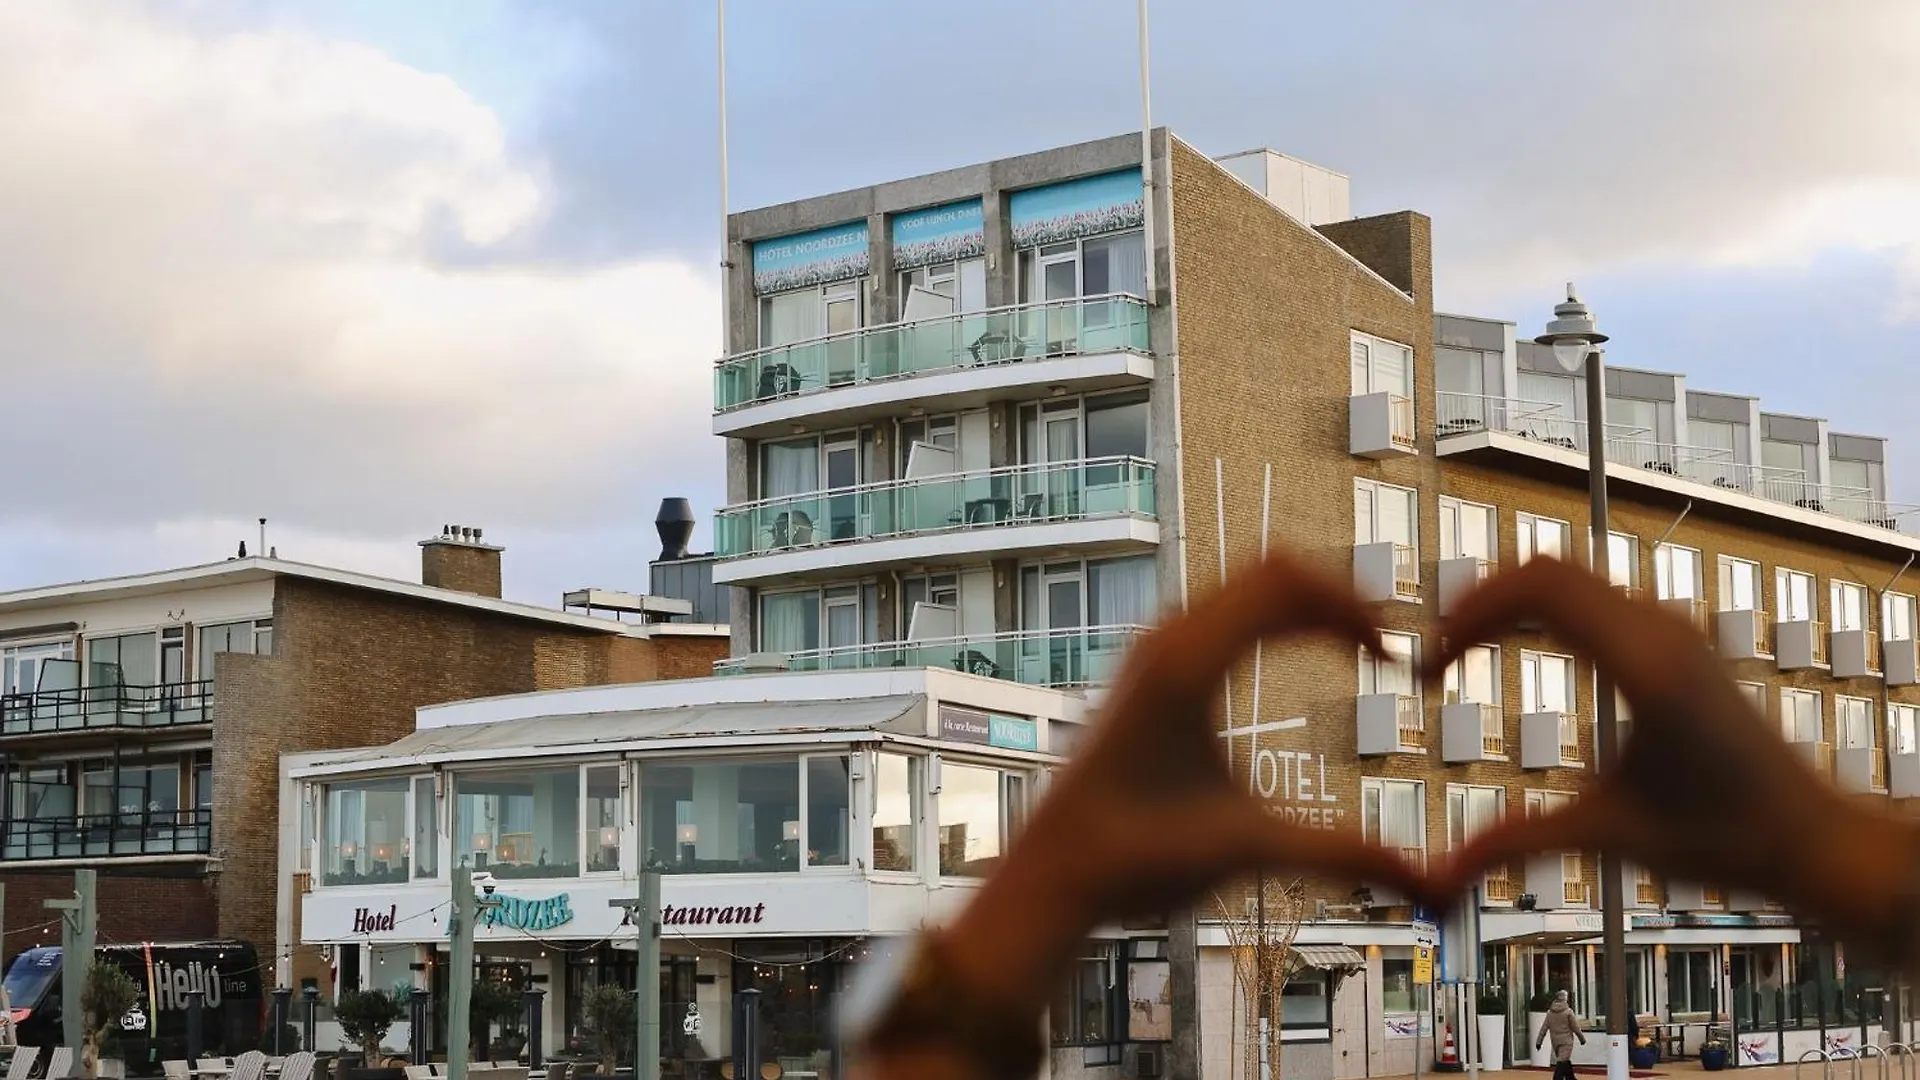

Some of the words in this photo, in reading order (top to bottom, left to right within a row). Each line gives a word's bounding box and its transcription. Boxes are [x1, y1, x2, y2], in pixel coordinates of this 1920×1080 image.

[759, 246, 793, 262] HOTEL
[352, 904, 397, 933] Hotel
[620, 902, 765, 926] Rtaurant
[155, 961, 221, 1011] Hello
